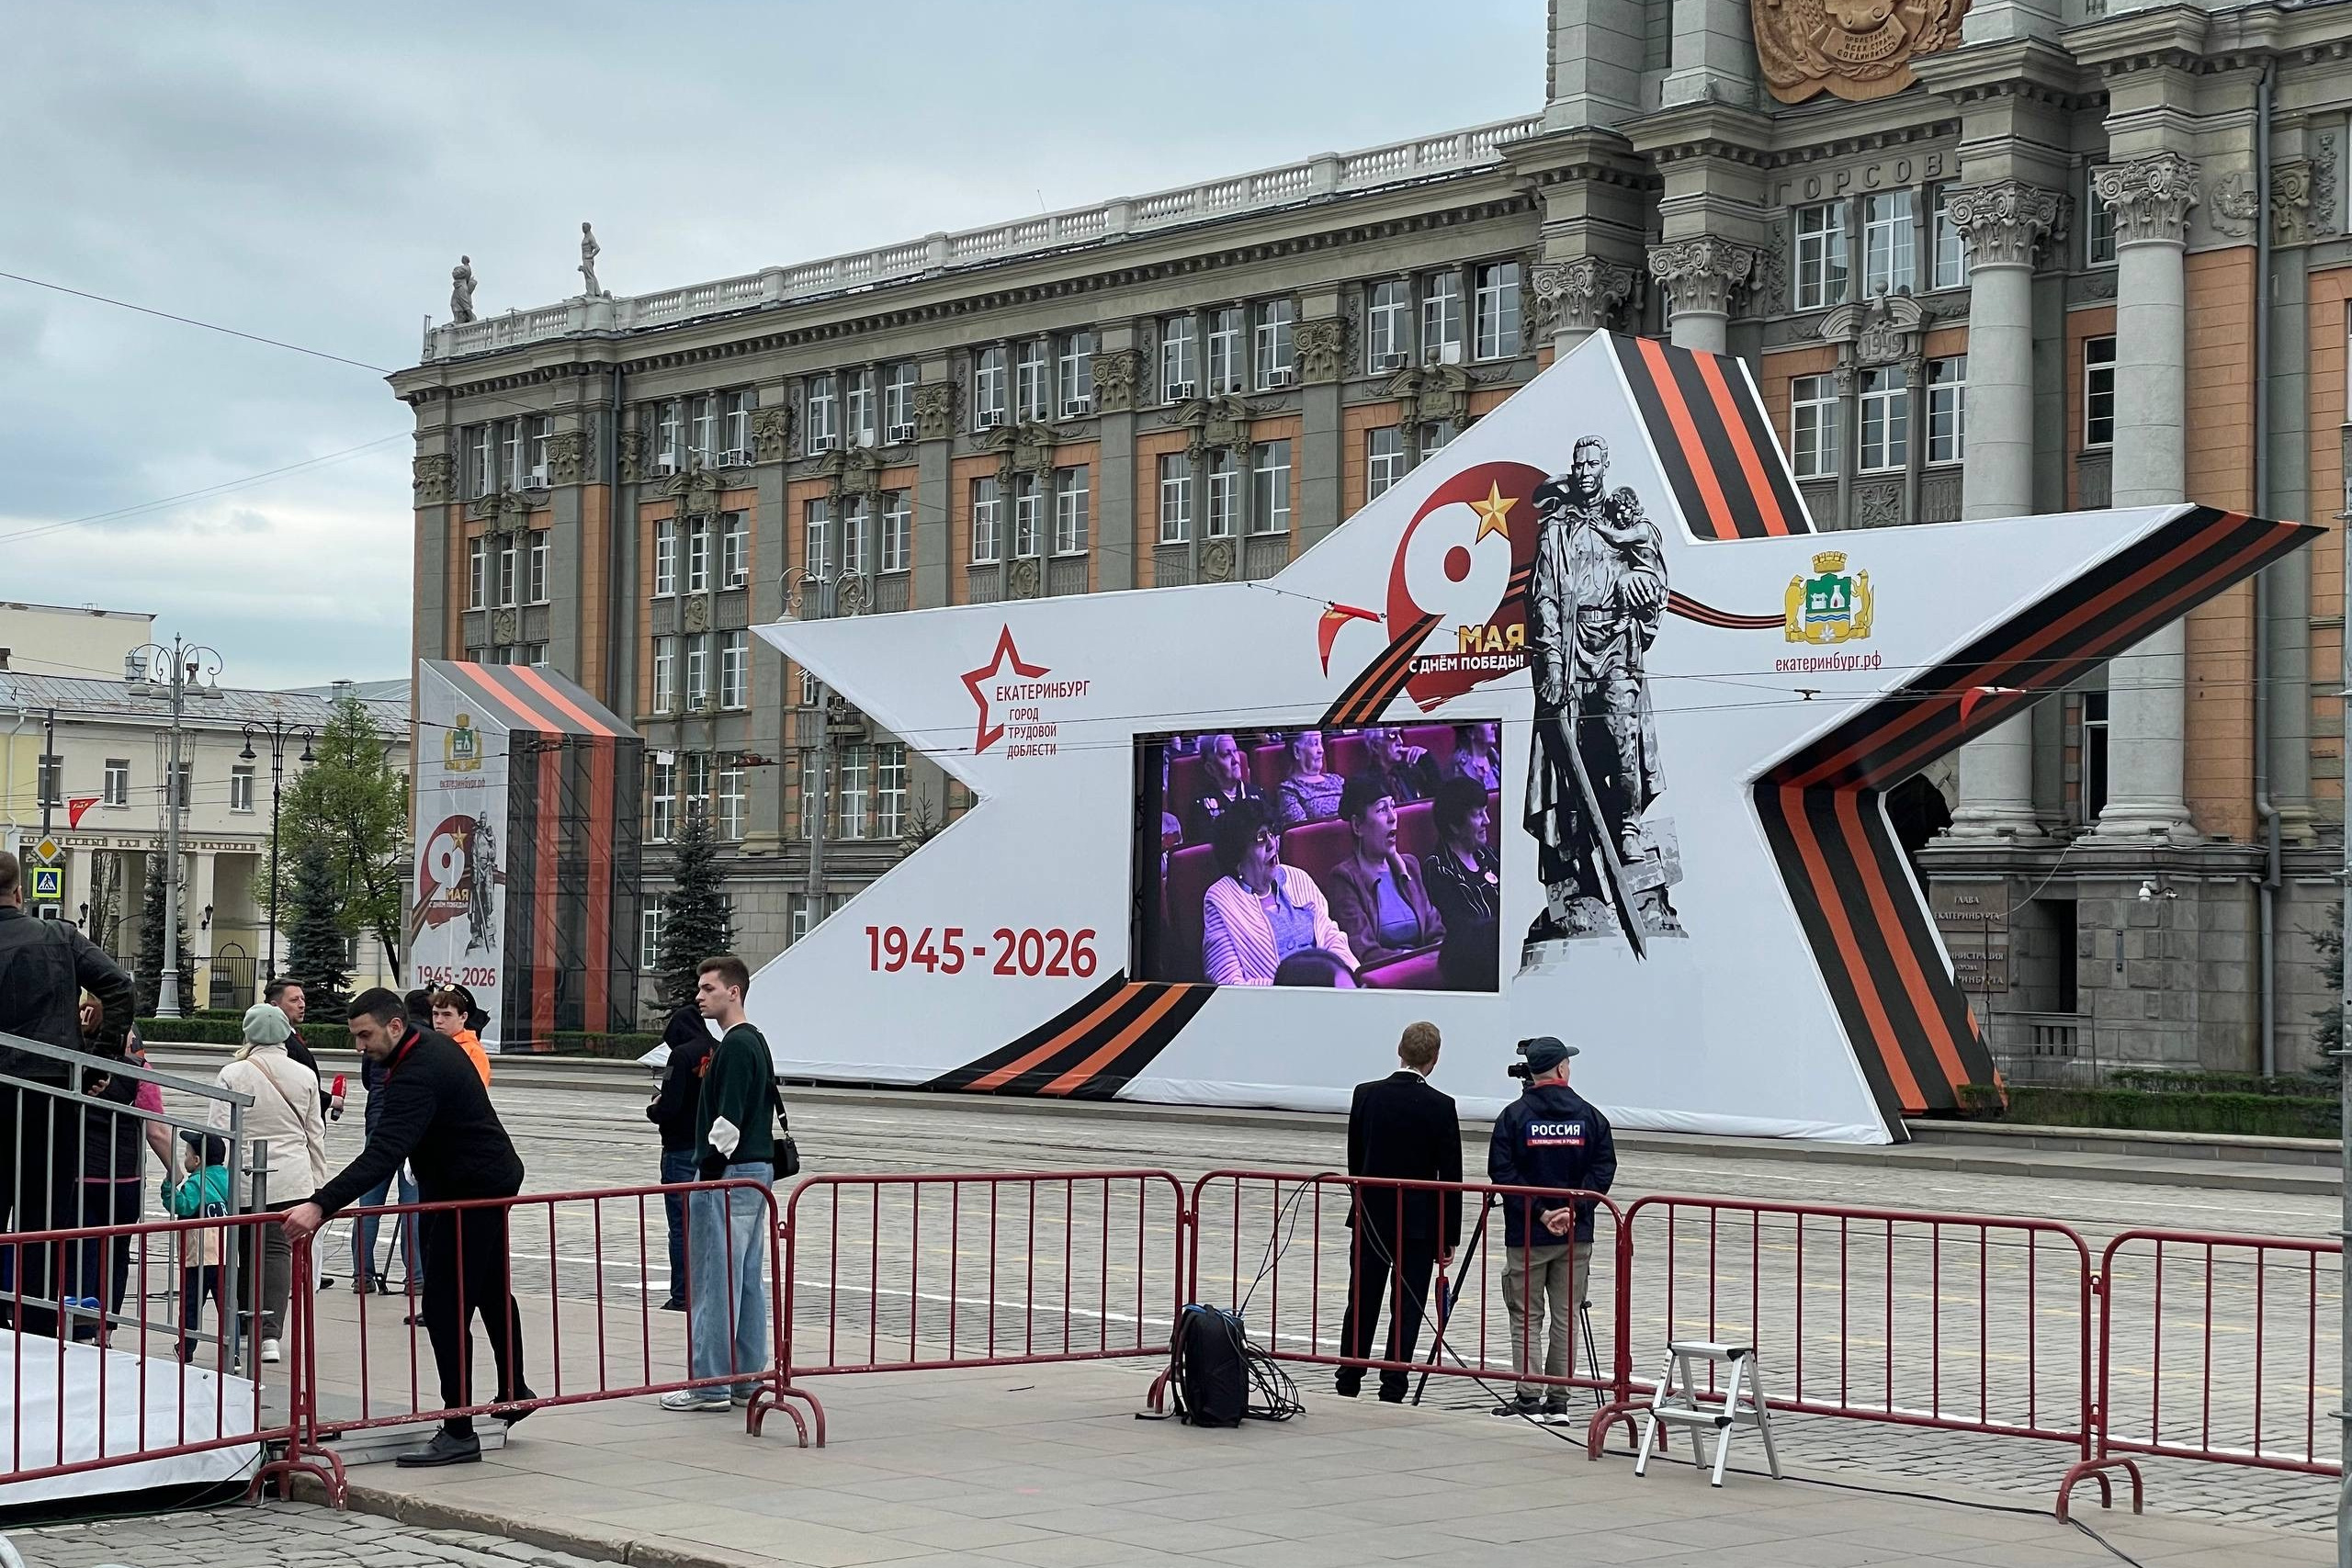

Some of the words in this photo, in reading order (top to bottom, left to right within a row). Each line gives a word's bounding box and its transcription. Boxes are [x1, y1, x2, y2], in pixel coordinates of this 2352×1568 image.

[1404, 502, 1512, 656] 9
[1458, 623, 1525, 654] МАЯ
[1408, 660, 1418, 673] С
[1419, 655, 1458, 674] ДНЁМ
[1461, 654, 1524, 671] ПОБЕДЫ!
[1776, 650, 1882, 672] екатеринбург.рф
[996, 680, 1091, 702] ЕКАТЕРИНБУРГ
[1009, 707, 1039, 722] ГОРОД
[1008, 723, 1057, 740] ТРУДОВОЙ
[1007, 743, 1057, 760] ДОБЛЕСТИ
[446, 887, 469, 901] МАЯ
[1954, 896, 1980, 904] ГЛАВА
[1531, 1124, 1580, 1136] РОССИЯ
